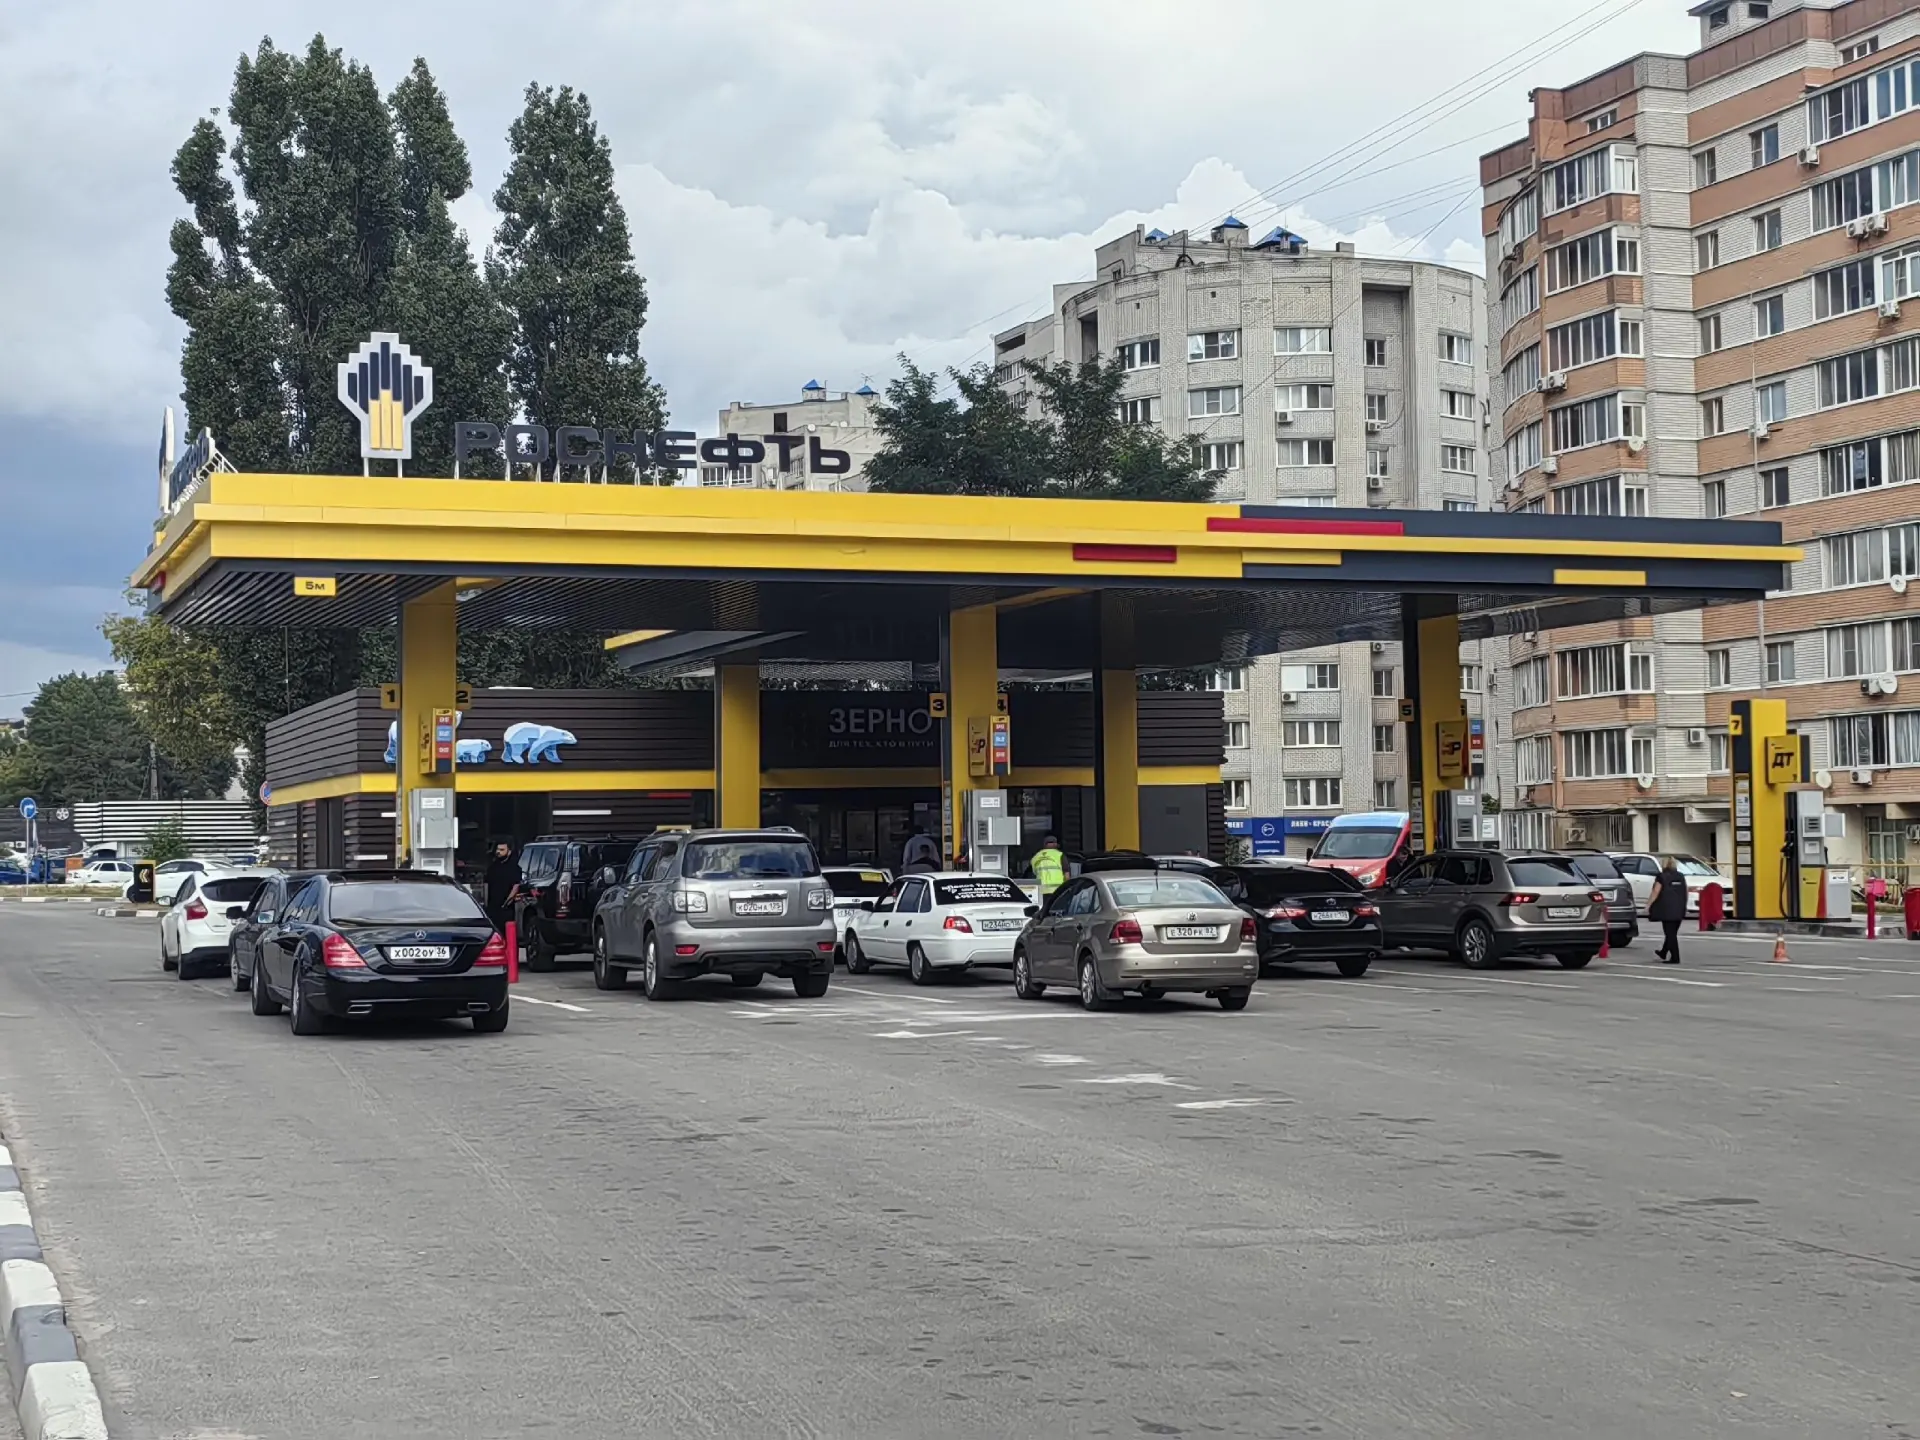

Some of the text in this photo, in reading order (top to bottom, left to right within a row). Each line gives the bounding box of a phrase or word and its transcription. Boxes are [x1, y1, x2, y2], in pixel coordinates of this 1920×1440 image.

[454, 421, 851, 474] РОСНЕФТЬ
[386, 689, 396, 703] 1
[456, 690, 469, 703] 2
[932, 699, 945, 712] 3
[997, 699, 1007, 711] 4
[1401, 704, 1412, 716] 5
[828, 707, 933, 734] ЗЕРНО
[1731, 720, 1740, 730] 7
[1771, 752, 1795, 769] ДТ
[436, 946, 447, 955] 36
